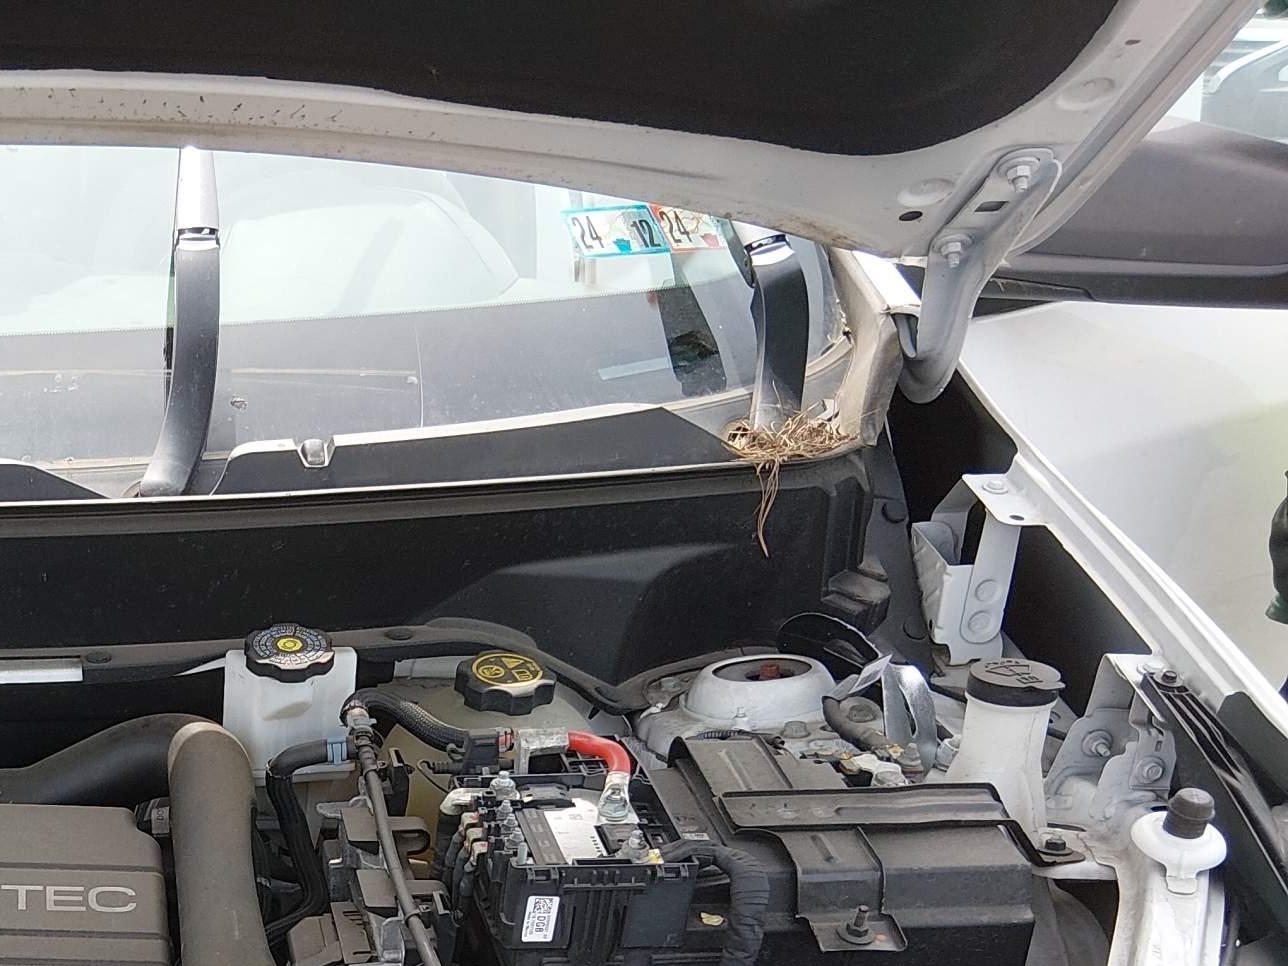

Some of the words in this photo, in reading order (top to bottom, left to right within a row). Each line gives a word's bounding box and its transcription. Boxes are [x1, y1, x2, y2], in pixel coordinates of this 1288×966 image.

[571, 215, 605, 249] 24
[630, 218, 662, 248] 12
[658, 210, 693, 244] 24
